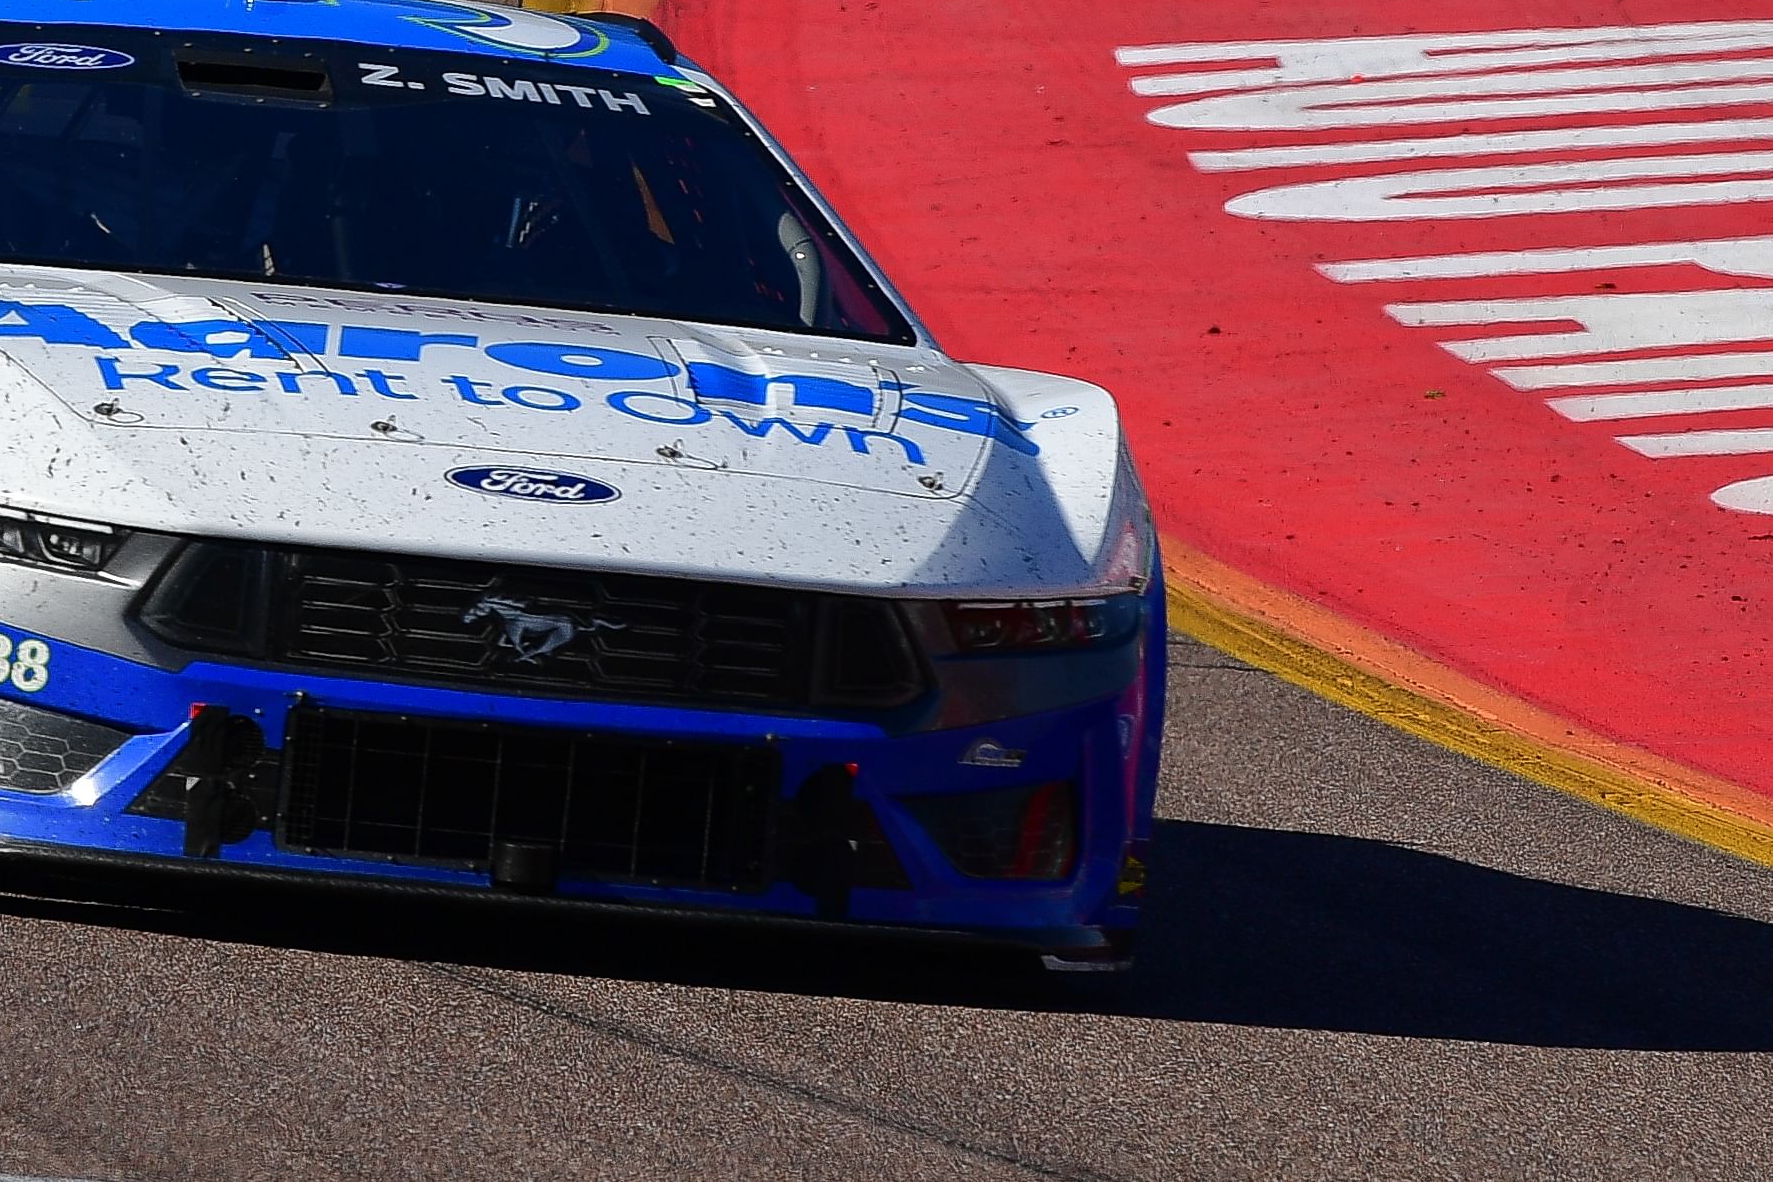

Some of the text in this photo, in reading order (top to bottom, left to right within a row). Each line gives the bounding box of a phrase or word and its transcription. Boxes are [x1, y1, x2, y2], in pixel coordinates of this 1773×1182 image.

[358, 62, 652, 116] Z. SMITH
[94, 355, 927, 467] Rent to Own
